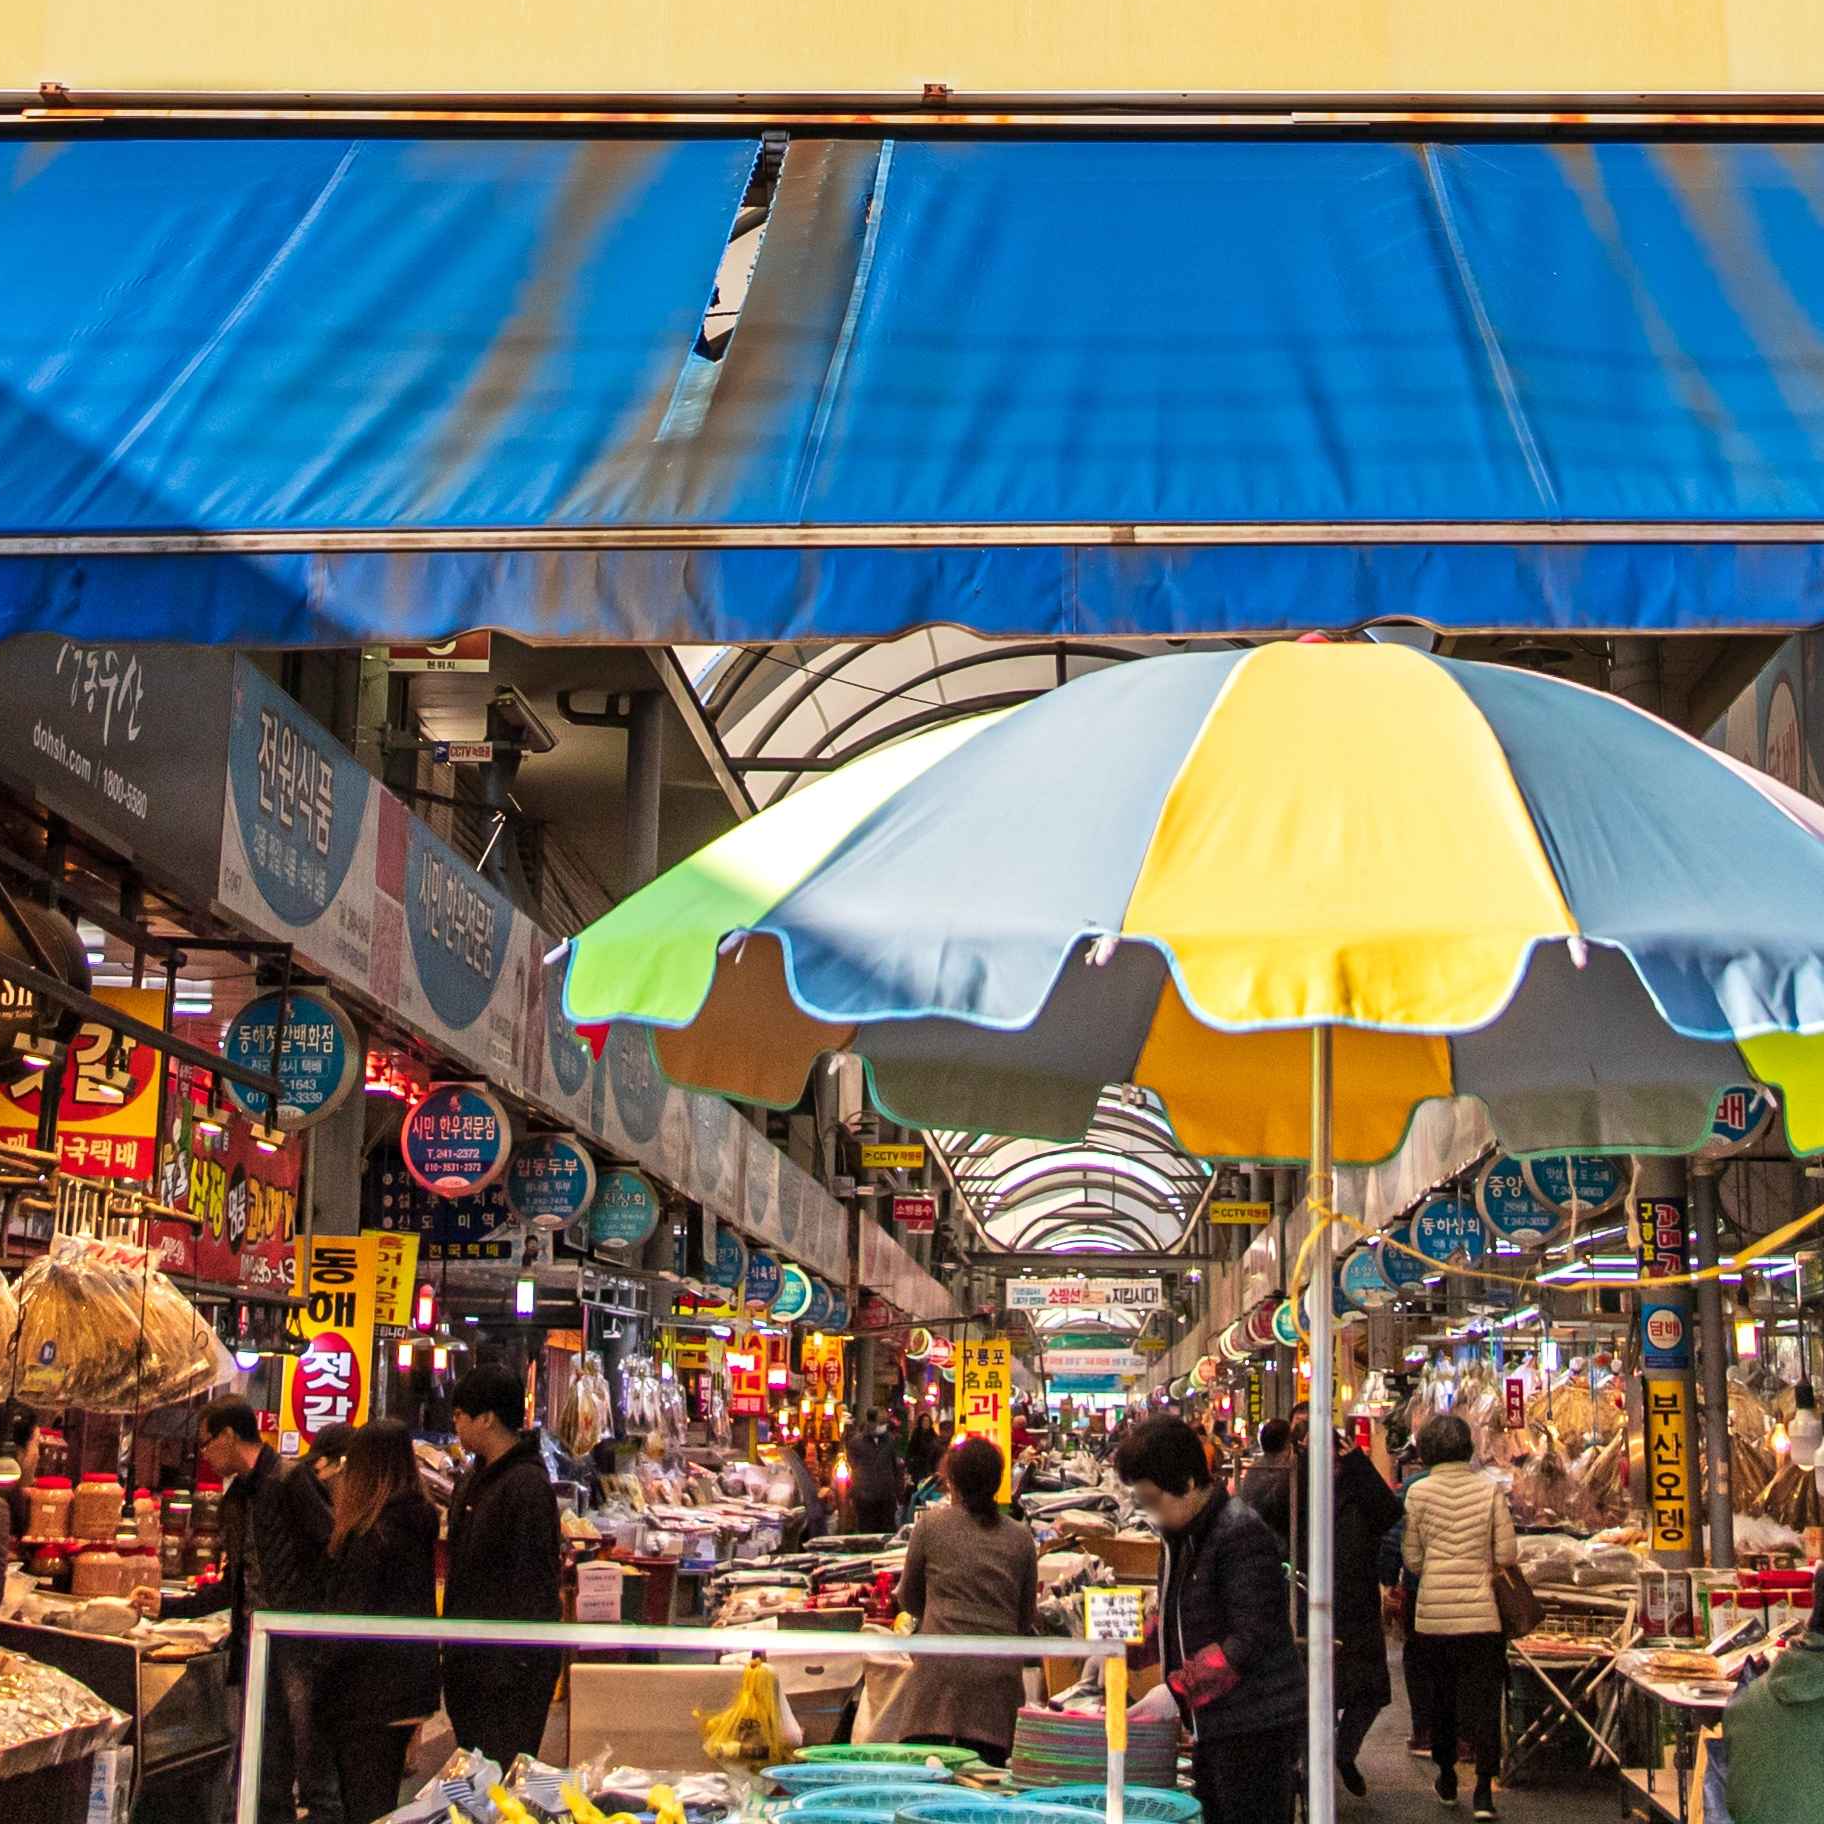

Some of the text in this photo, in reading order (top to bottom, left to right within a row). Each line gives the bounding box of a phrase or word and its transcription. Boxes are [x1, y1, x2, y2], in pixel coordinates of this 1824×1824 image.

[33, 720, 92, 783] dohsh.com
[257, 710, 333, 857] 전원식품
[440, 1115, 496, 1141] 한우전문점
[300, 1248, 358, 1434] 동해 젓갈
[963, 1348, 1006, 1367] 구룡포
[1649, 1320, 1681, 1337] 담배
[1651, 1393, 1685, 1543] 부산오뎅
